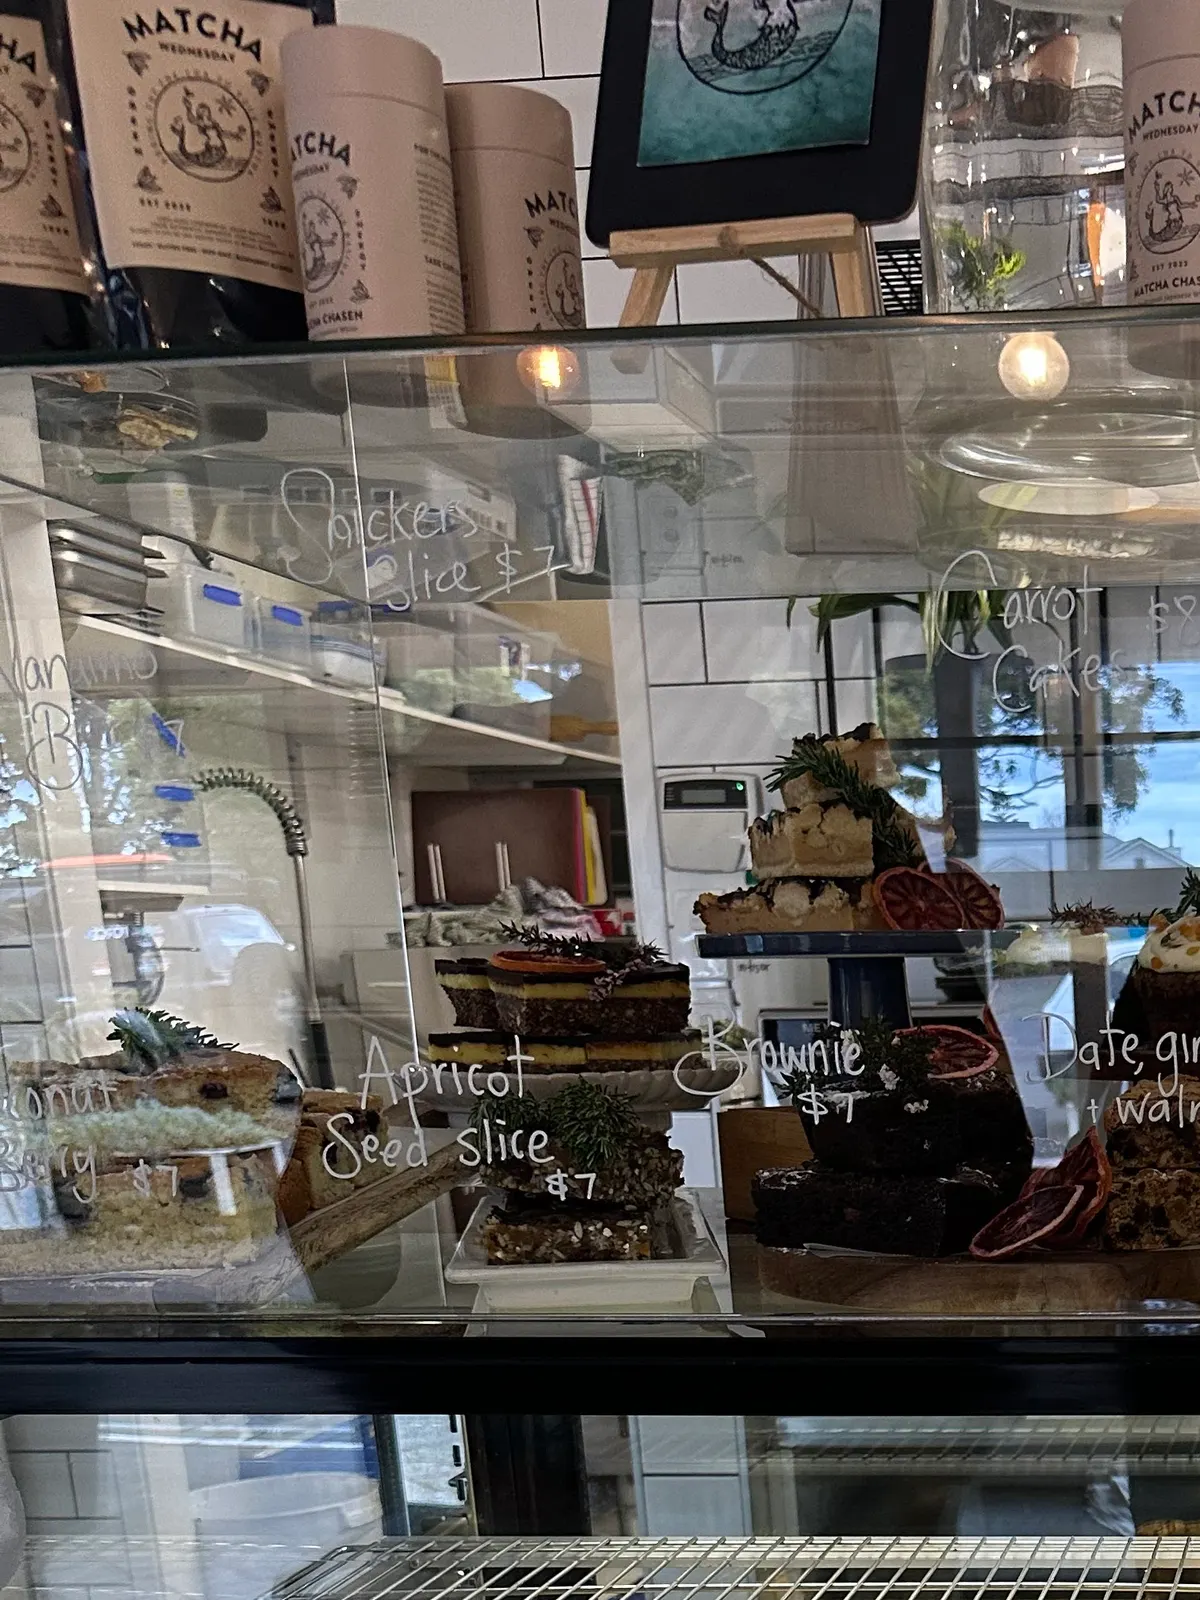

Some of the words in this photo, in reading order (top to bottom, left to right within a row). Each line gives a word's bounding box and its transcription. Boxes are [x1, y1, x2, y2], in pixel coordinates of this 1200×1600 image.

[122, 8, 262, 62] MATCHA
[1142, 124, 1199, 142] WEDNESDAY
[1134, 281, 1169, 298] MATCHA
[321, 310, 363, 325] CHASEN
[494, 542, 556, 595] $7
[934, 549, 1103, 661] Carrot
[1146, 594, 1197, 648] $8
[673, 1000, 866, 1097] Brownie
[359, 1035, 535, 1130] Apricot
[796, 1082, 854, 1125] $7
[1085, 1097, 1099, 1126] +
[322, 1111, 428, 1180] Seed
[456, 1118, 555, 1167] slice
[545, 1168, 597, 1201] $7
